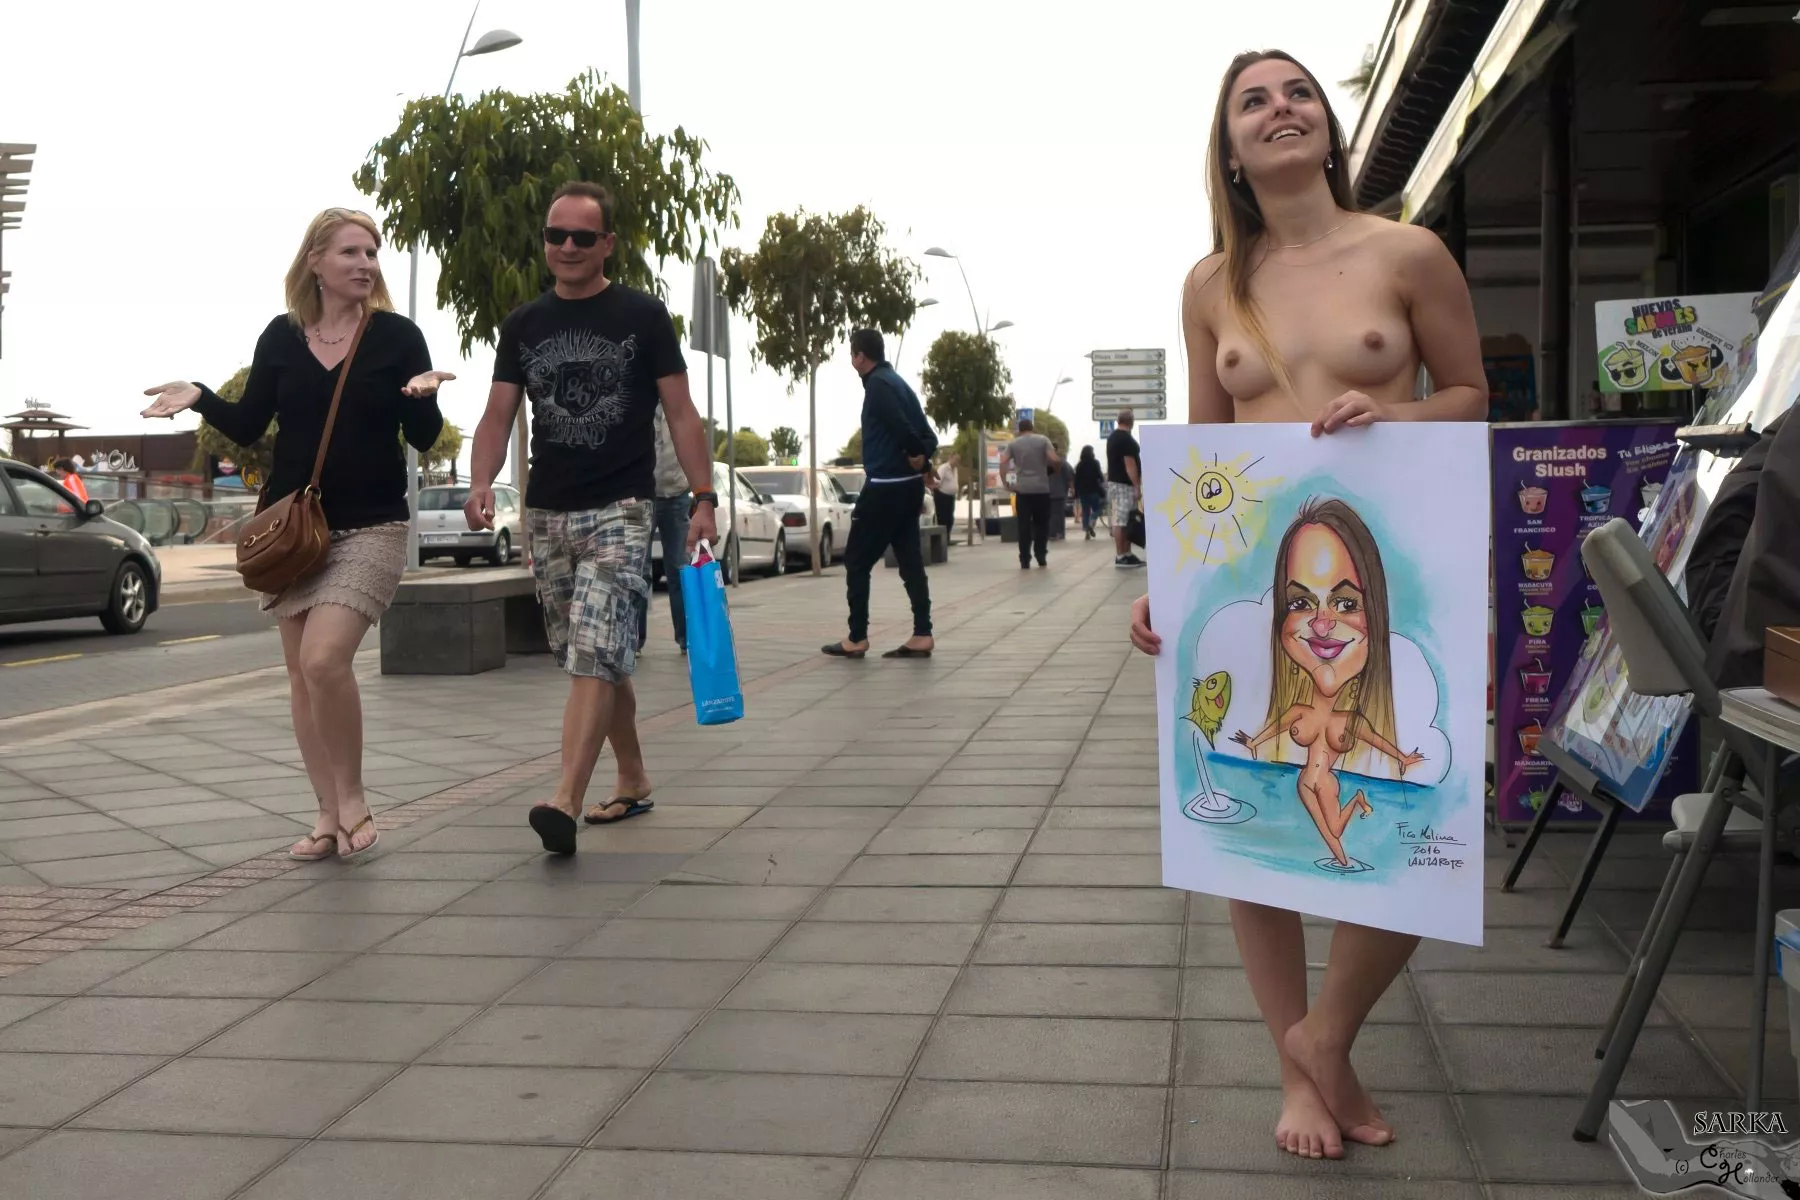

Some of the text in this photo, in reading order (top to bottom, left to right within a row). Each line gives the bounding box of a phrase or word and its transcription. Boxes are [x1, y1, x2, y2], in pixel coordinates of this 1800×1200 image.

[1632, 299, 1681, 317] NUEVOS
[1696, 326, 1723, 344] ENERGY
[1512, 445, 1607, 462] Granizados
[1535, 463, 1586, 478] Slush
[1410, 845, 1441, 855] 2016
[1408, 858, 1465, 870] LANZAROTE
